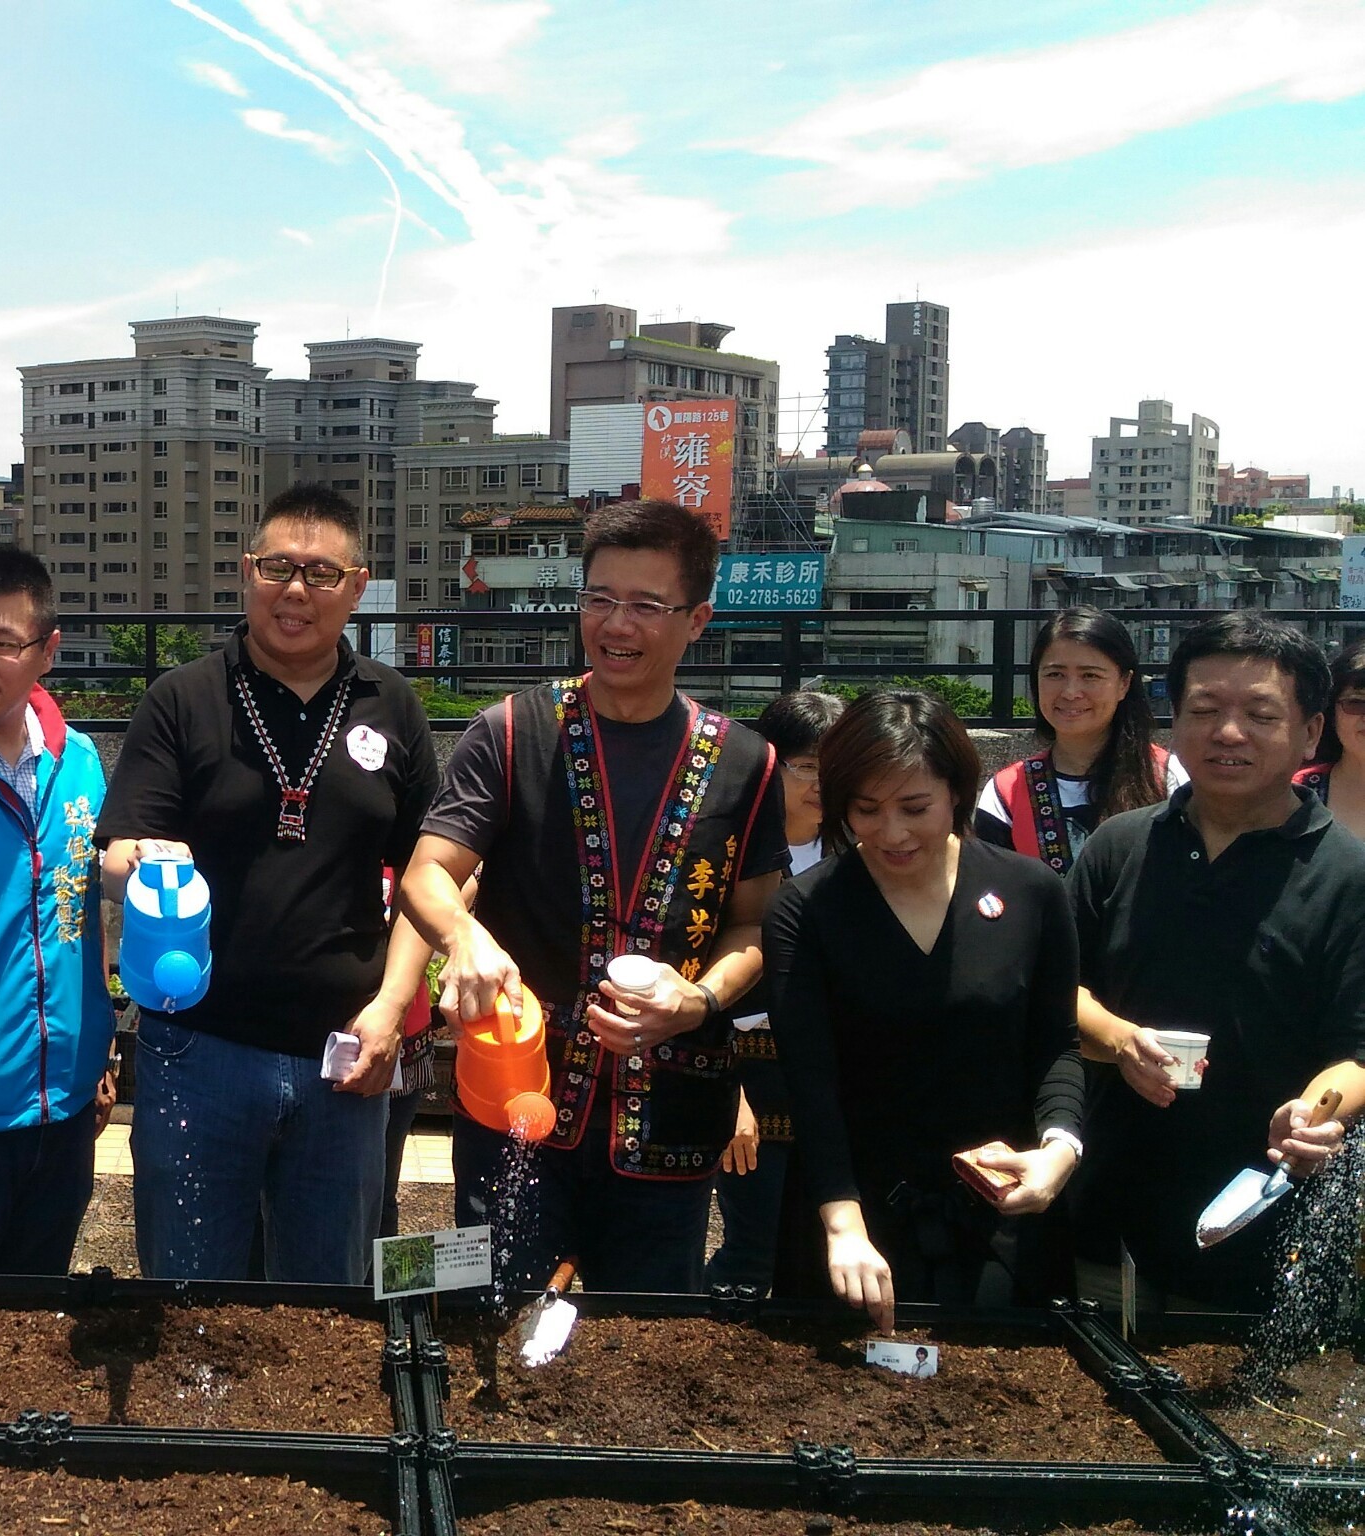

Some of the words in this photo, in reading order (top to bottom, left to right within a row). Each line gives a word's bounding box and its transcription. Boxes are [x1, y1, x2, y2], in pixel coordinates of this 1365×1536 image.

[672, 432, 711, 508] 雍容
[728, 560, 819, 584] 康禾診所
[727, 589, 817, 605] 02-2785-5629
